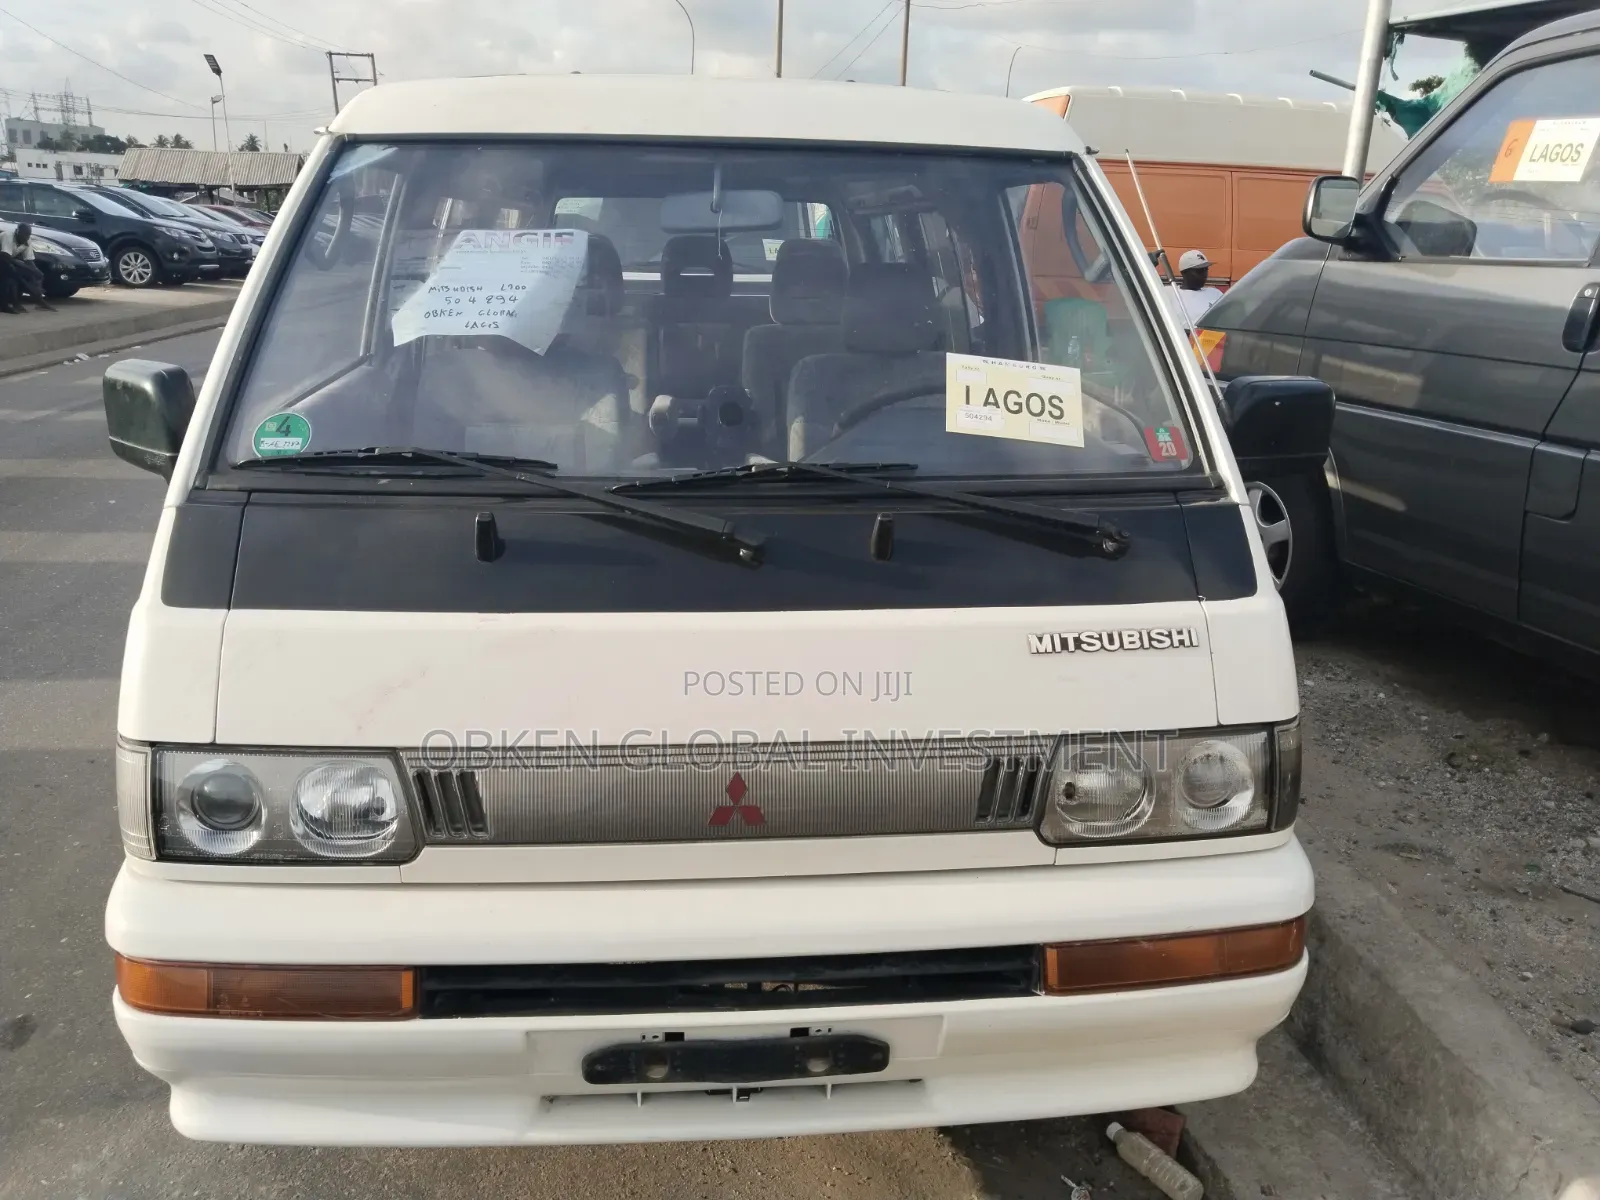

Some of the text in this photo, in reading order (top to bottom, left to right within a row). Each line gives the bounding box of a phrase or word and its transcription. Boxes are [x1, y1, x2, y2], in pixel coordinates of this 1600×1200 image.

[1529, 143, 1584, 163] LAGOS
[276, 416, 291, 437] 4
[1158, 441, 1177, 457] 20
[1027, 627, 1199, 654] MITSUBISHI
